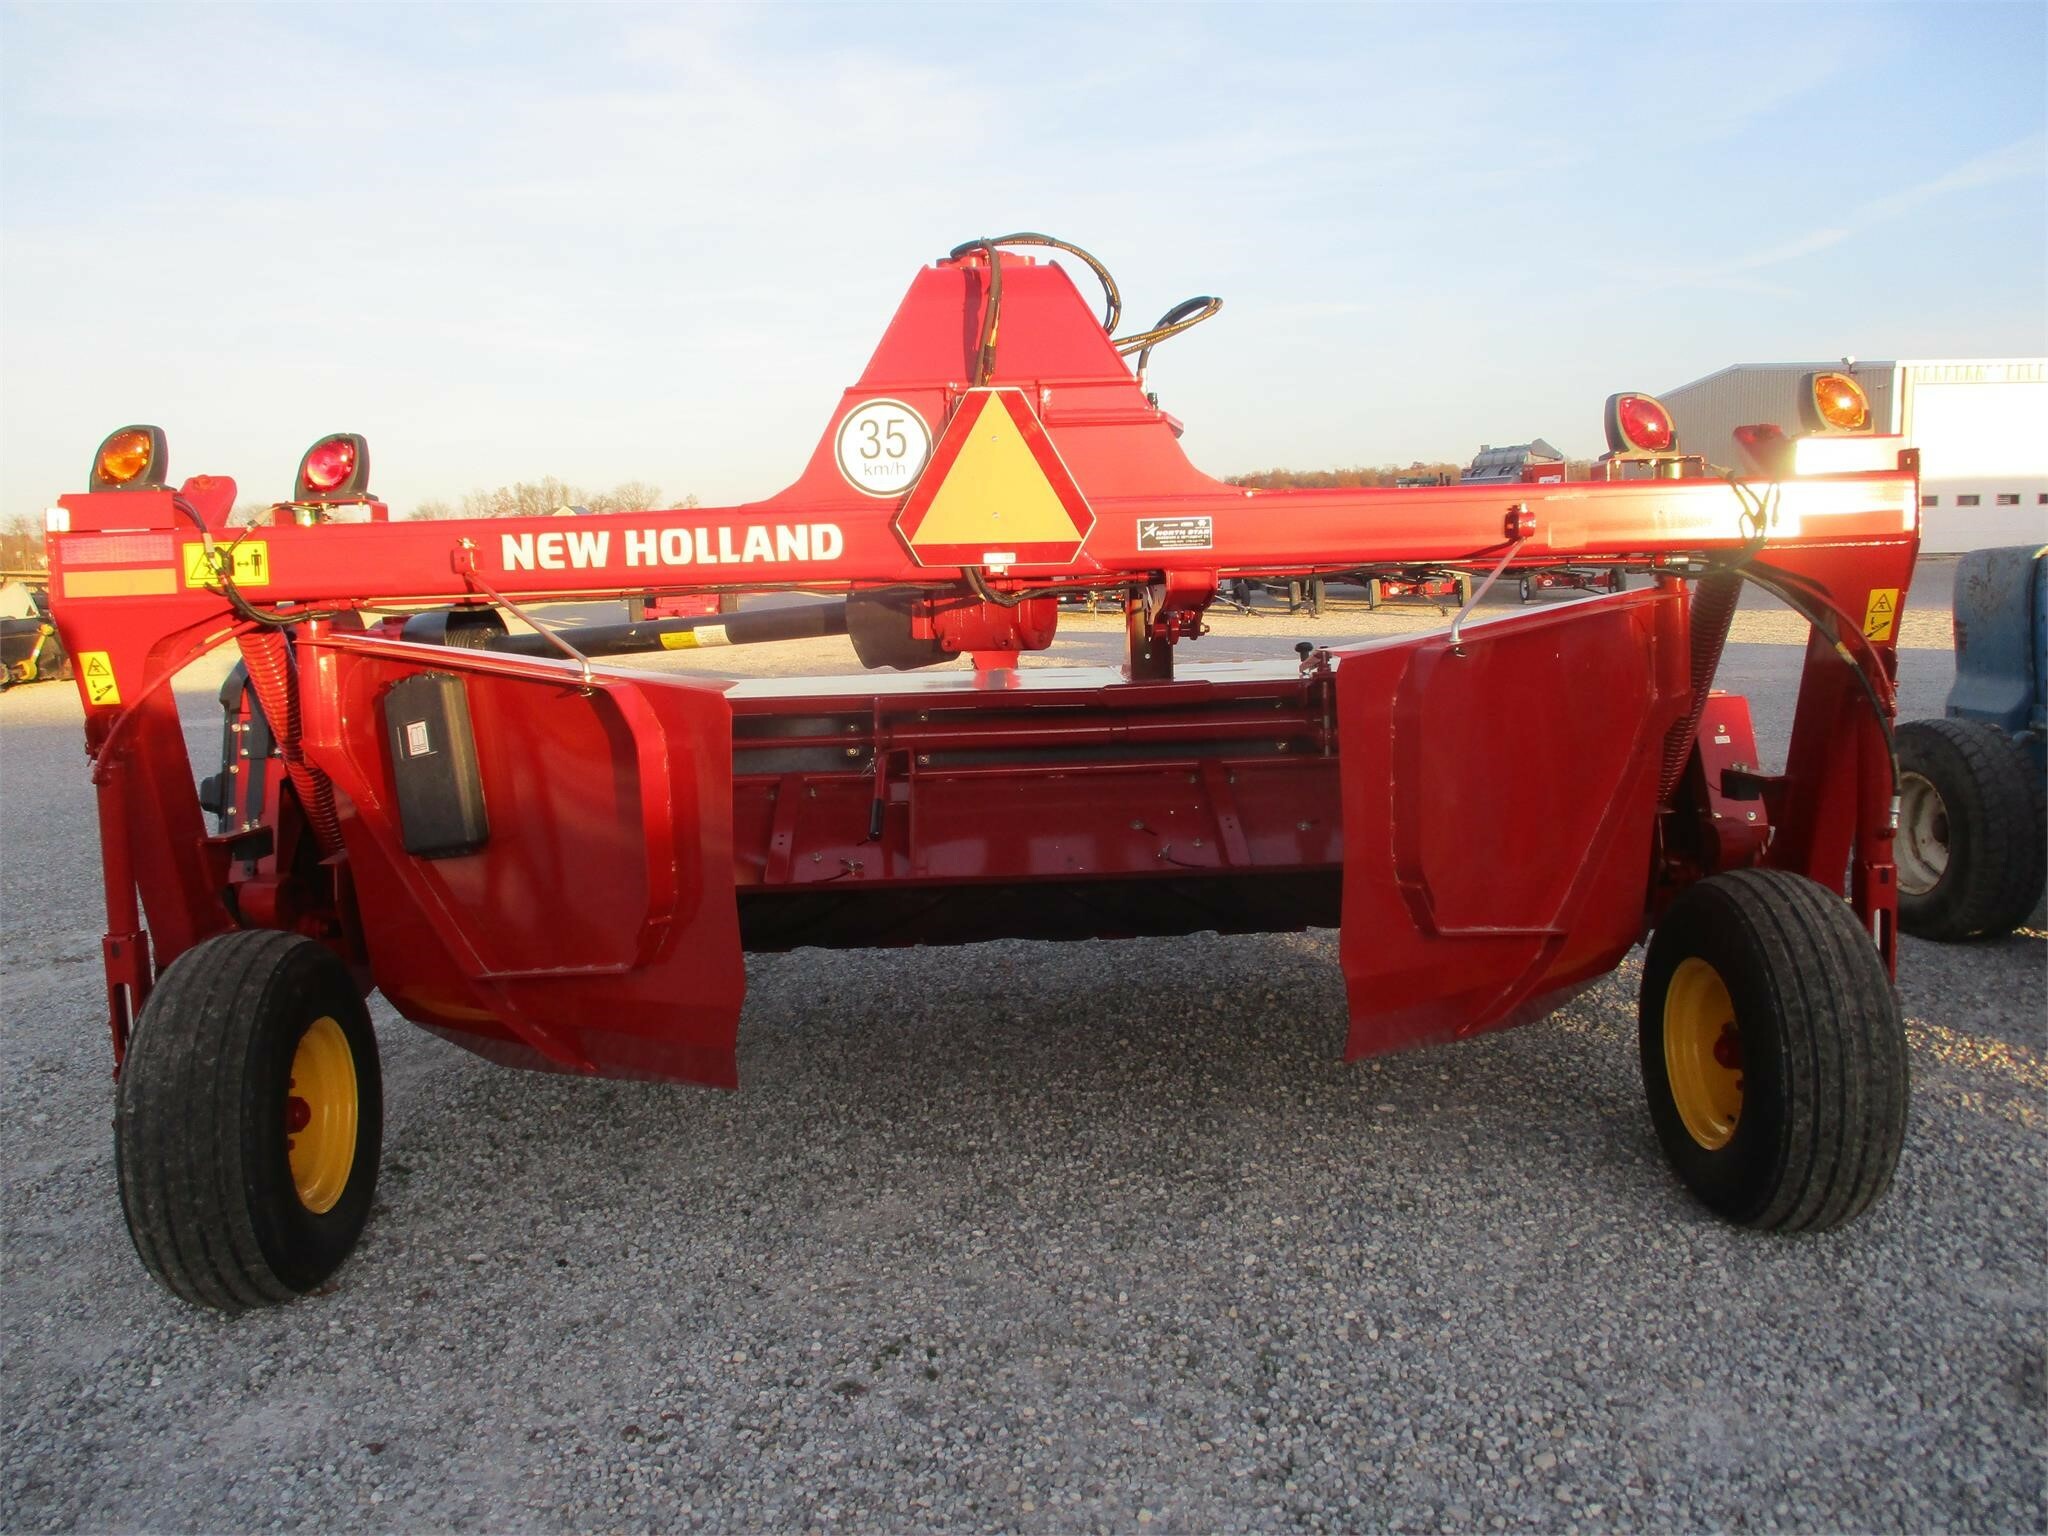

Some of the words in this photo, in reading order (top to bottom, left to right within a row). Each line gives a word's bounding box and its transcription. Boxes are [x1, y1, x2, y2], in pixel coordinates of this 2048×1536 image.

[860, 419, 906, 459] 35
[864, 462, 905, 475] km/h
[501, 531, 609, 571] NEW
[625, 523, 843, 566] HOLLAND
